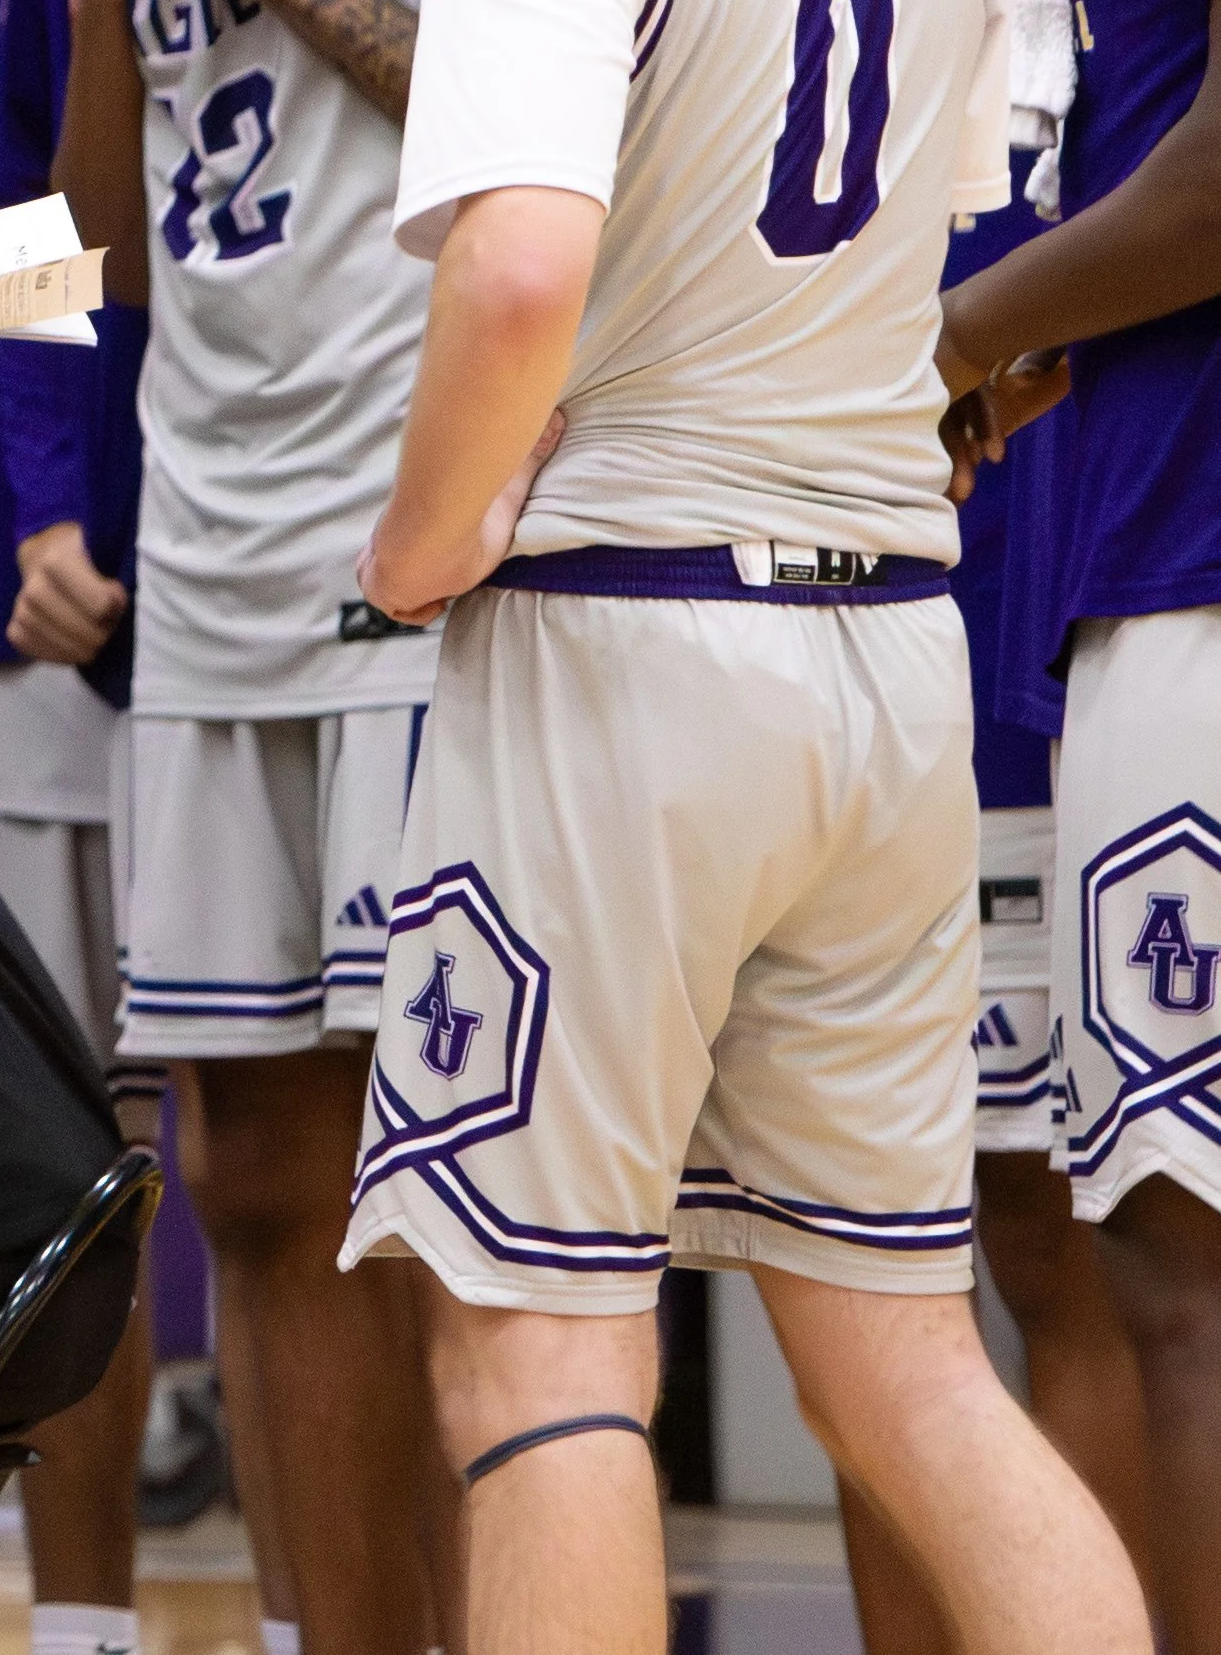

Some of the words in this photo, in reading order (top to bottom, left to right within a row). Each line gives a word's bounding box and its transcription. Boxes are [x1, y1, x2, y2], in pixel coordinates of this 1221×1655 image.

[151, 66, 292, 264] 12
[403, 951, 483, 1081] AU
[1127, 892, 1221, 1016] AU
